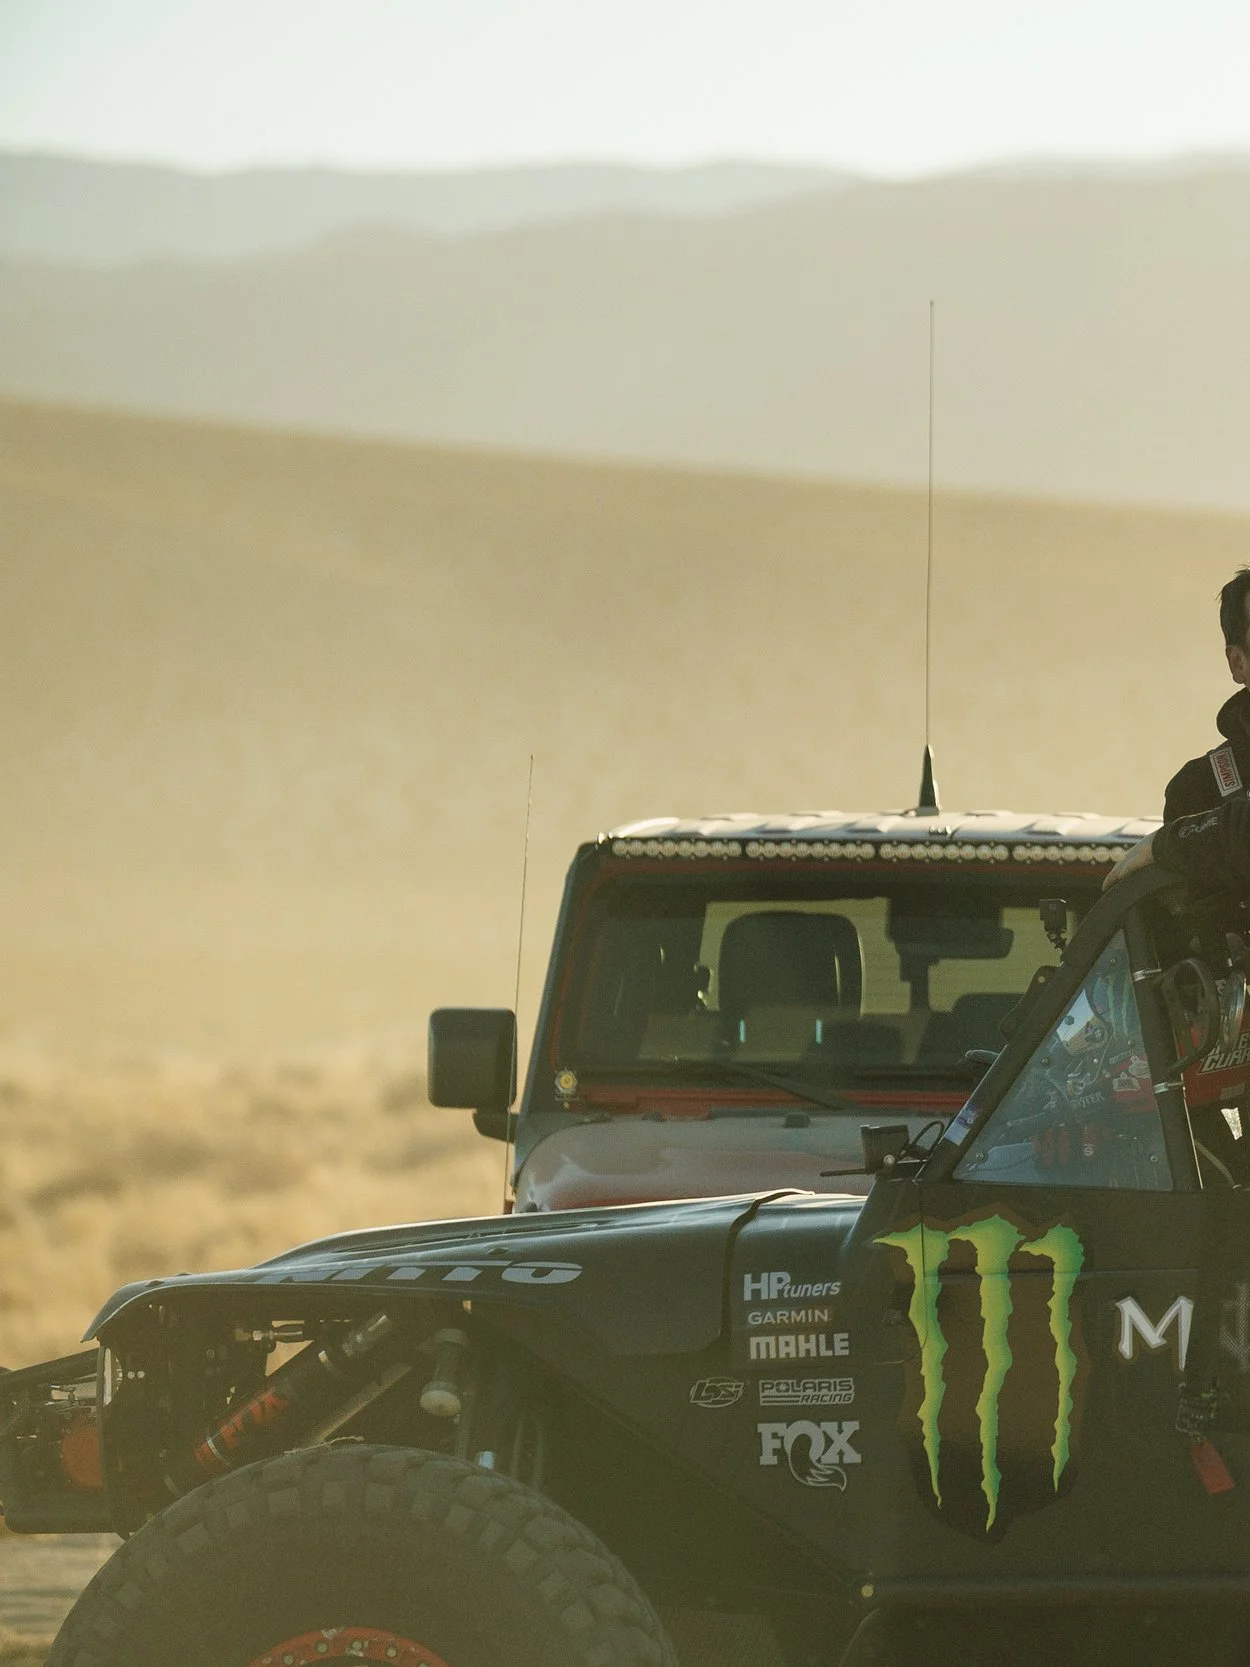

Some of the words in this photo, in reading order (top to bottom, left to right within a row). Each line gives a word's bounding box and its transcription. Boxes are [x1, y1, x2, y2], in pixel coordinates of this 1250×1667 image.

[1215, 753, 1235, 788] SIMPSON
[748, 1309, 828, 1325] GARMIN
[751, 1333, 849, 1359] MAHLE
[761, 1380, 853, 1393] POLARIS
[800, 1393, 854, 1404] RACING
[757, 1420, 862, 1491] FOX
